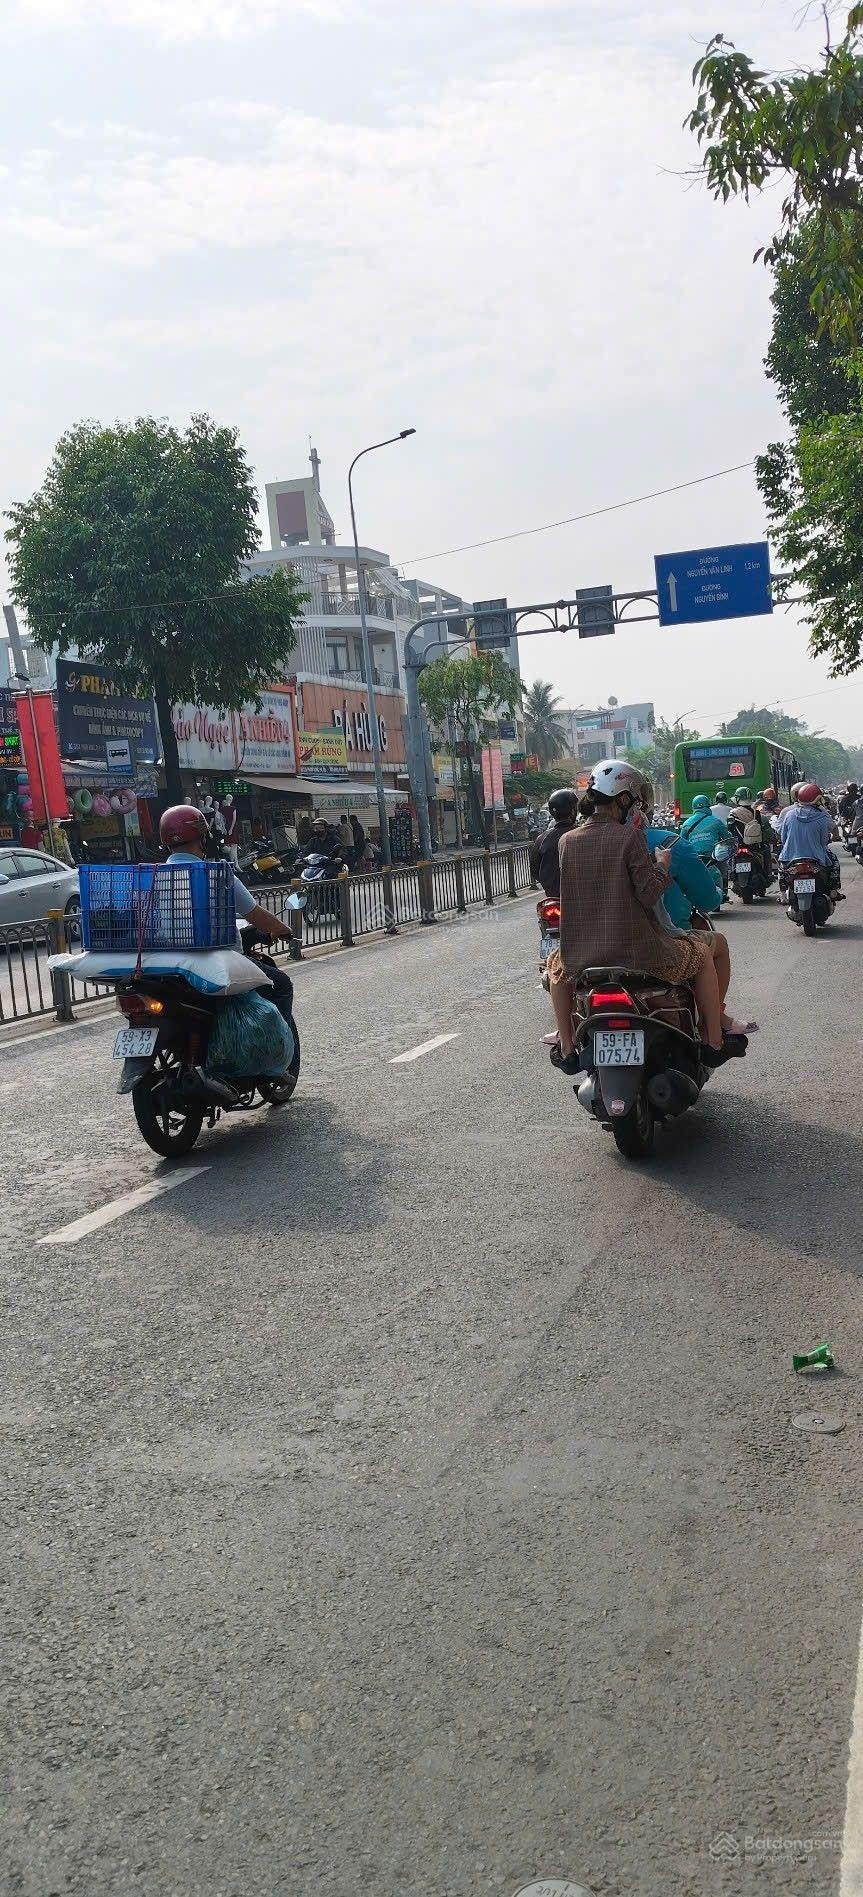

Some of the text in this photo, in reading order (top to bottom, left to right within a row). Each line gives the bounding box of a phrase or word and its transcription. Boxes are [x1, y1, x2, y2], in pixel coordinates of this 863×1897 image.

[687, 565, 708, 578] NGUYỄN
[721, 564, 733, 573] LINH
[731, 766, 742, 774] 59
[122, 1030, 152, 1042] 59-X3
[602, 1033, 637, 1047] 59-FA
[115, 1043, 152, 1057] 454.28
[598, 1048, 640, 1064] 075.74
